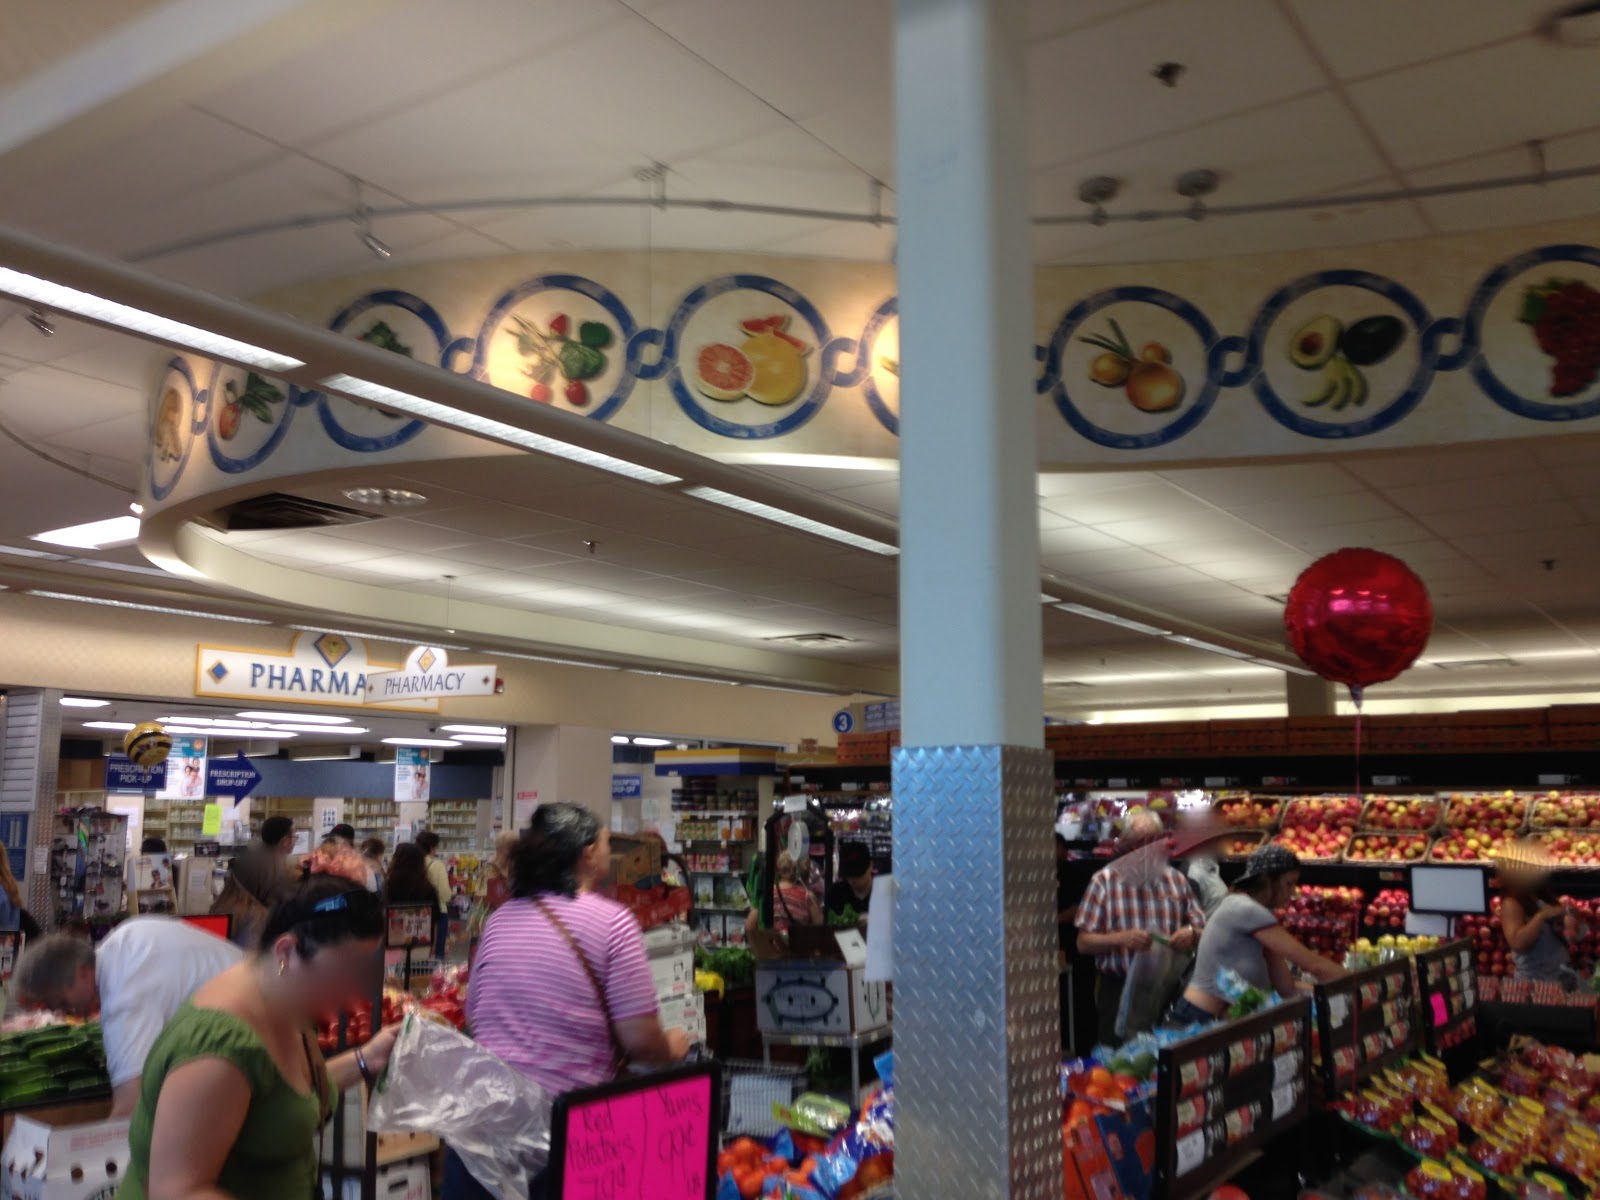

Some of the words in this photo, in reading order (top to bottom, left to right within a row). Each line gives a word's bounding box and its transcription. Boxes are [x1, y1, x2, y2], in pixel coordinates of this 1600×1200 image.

[384, 672, 466, 695] PHARMACY
[838, 714, 849, 731] 3
[210, 769, 256, 778] PRESCRIPTION
[120, 774, 153, 783] PICK-UP
[216, 778, 248, 787] DROP-OFF
